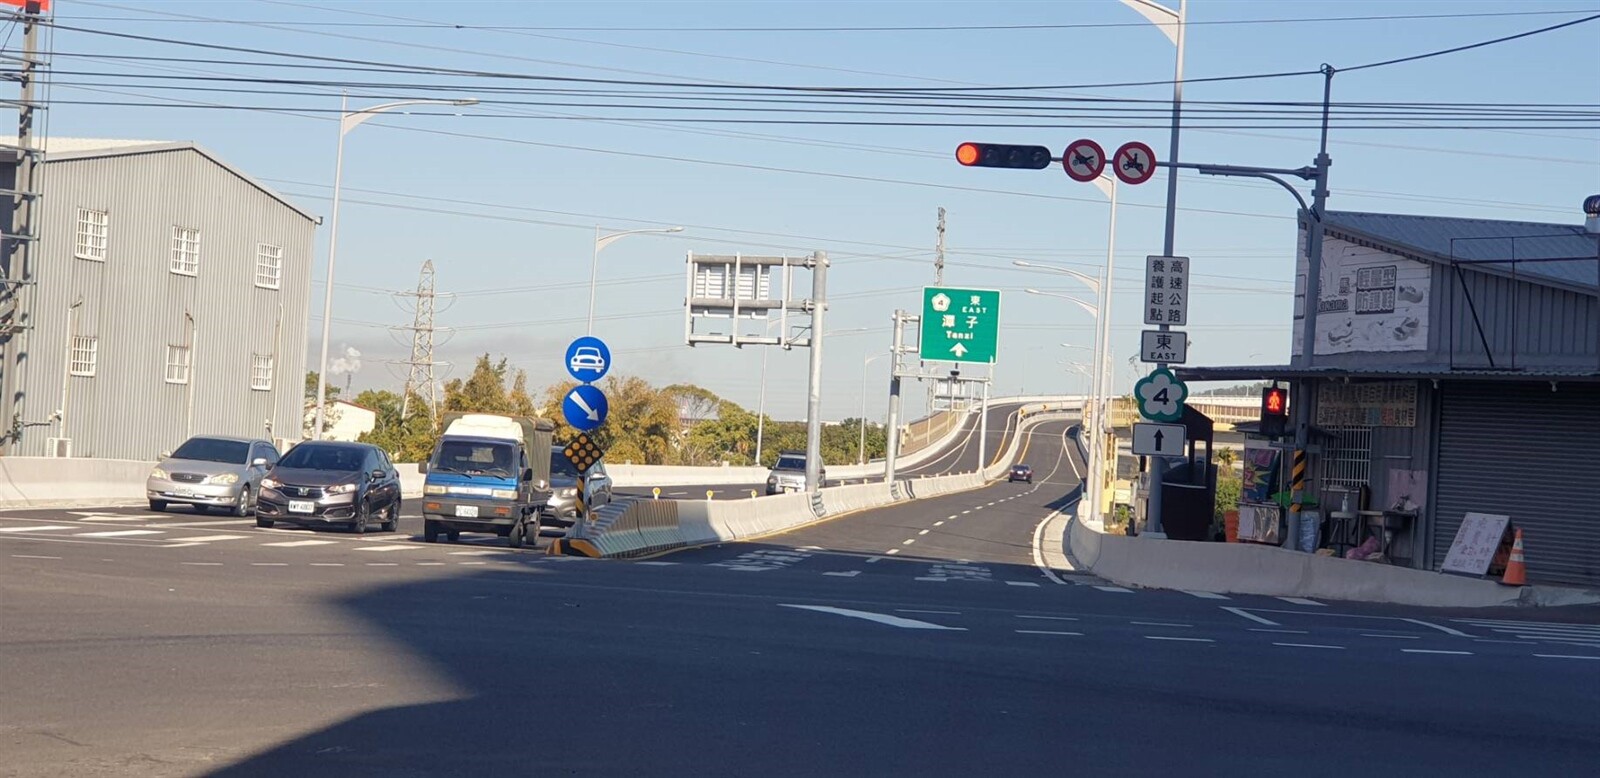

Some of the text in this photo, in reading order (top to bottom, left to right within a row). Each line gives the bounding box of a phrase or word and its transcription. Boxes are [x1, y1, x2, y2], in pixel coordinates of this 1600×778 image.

[1358, 268, 1395, 289] 輕量型
[1150, 260, 1165, 321] 養護起點
[1168, 260, 1183, 322] 高速公路
[970, 295, 981, 306] 東
[962, 306, 987, 314] EAST
[942, 314, 979, 329] 潭子
[946, 330, 974, 339] Tanzi
[1156, 334, 1172, 350] 東
[1150, 351, 1177, 360] EAST
[1152, 387, 1170, 406] 4
